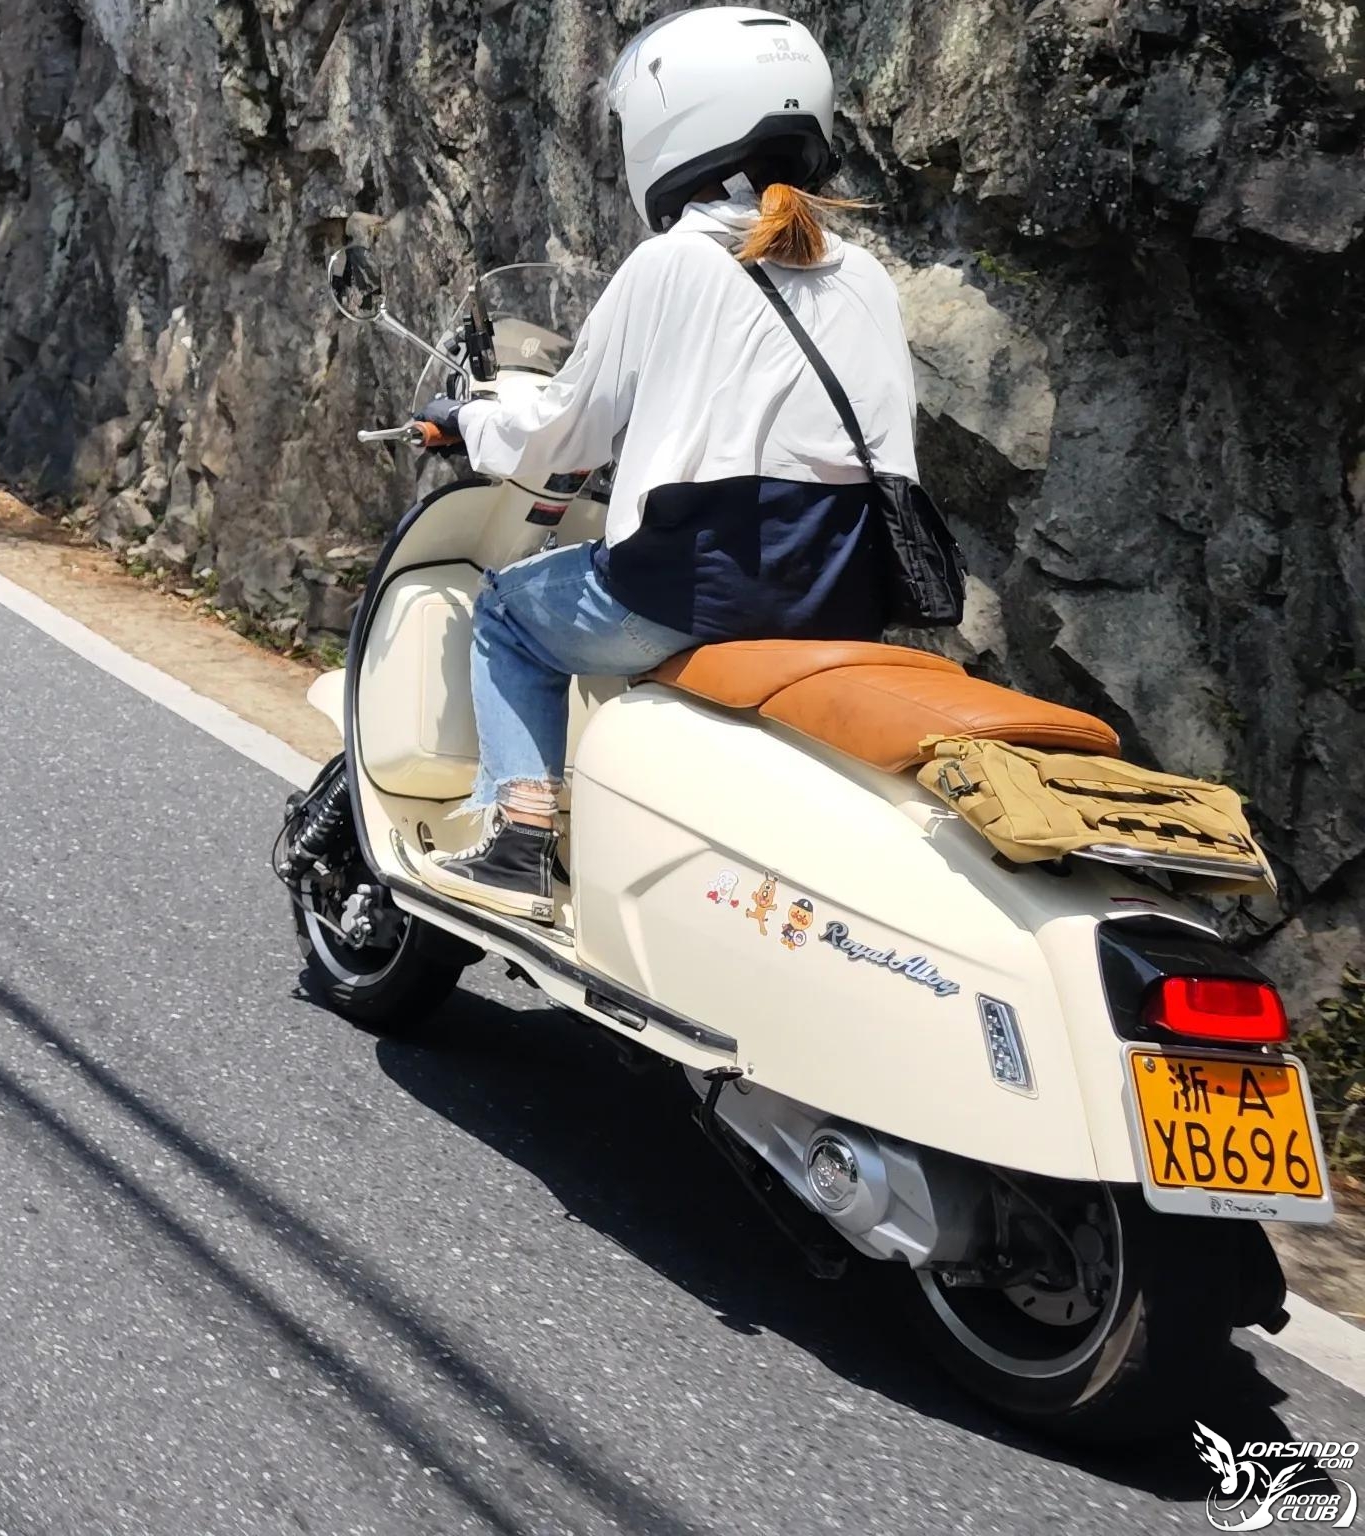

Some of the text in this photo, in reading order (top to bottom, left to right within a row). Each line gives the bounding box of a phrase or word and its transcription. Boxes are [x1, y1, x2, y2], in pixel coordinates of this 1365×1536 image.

[756, 50, 812, 64] SHARK
[818, 920, 960, 997] Royal Alloy
[1154, 1119, 1310, 1189] XB696
